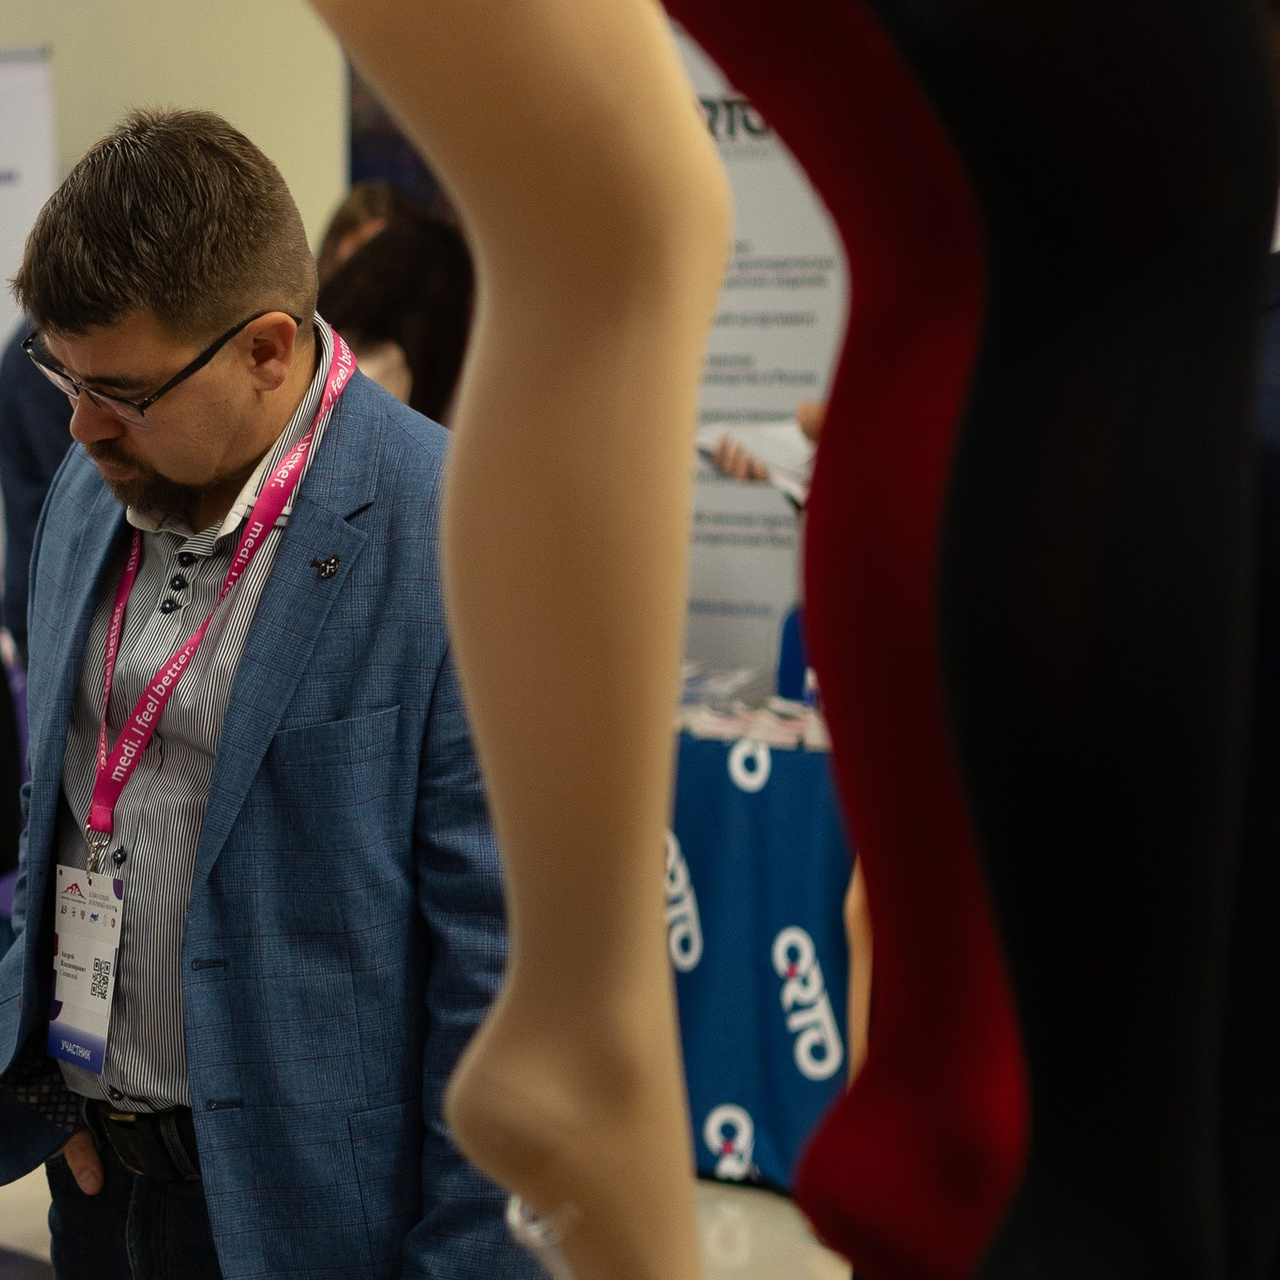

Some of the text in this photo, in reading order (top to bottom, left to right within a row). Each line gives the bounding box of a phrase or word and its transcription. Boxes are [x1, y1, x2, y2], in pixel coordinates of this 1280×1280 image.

[331, 362, 349, 394] feel
[271, 441, 311, 488] better.
[234, 521, 264, 567] medi.
[107, 602, 123, 659] better.
[111, 646, 195, 782] medi. I feel better.
[666, 829, 703, 972] RTO
[771, 926, 844, 1081] ORTO
[61, 1039, 92, 1061] УЧАСТНИК
